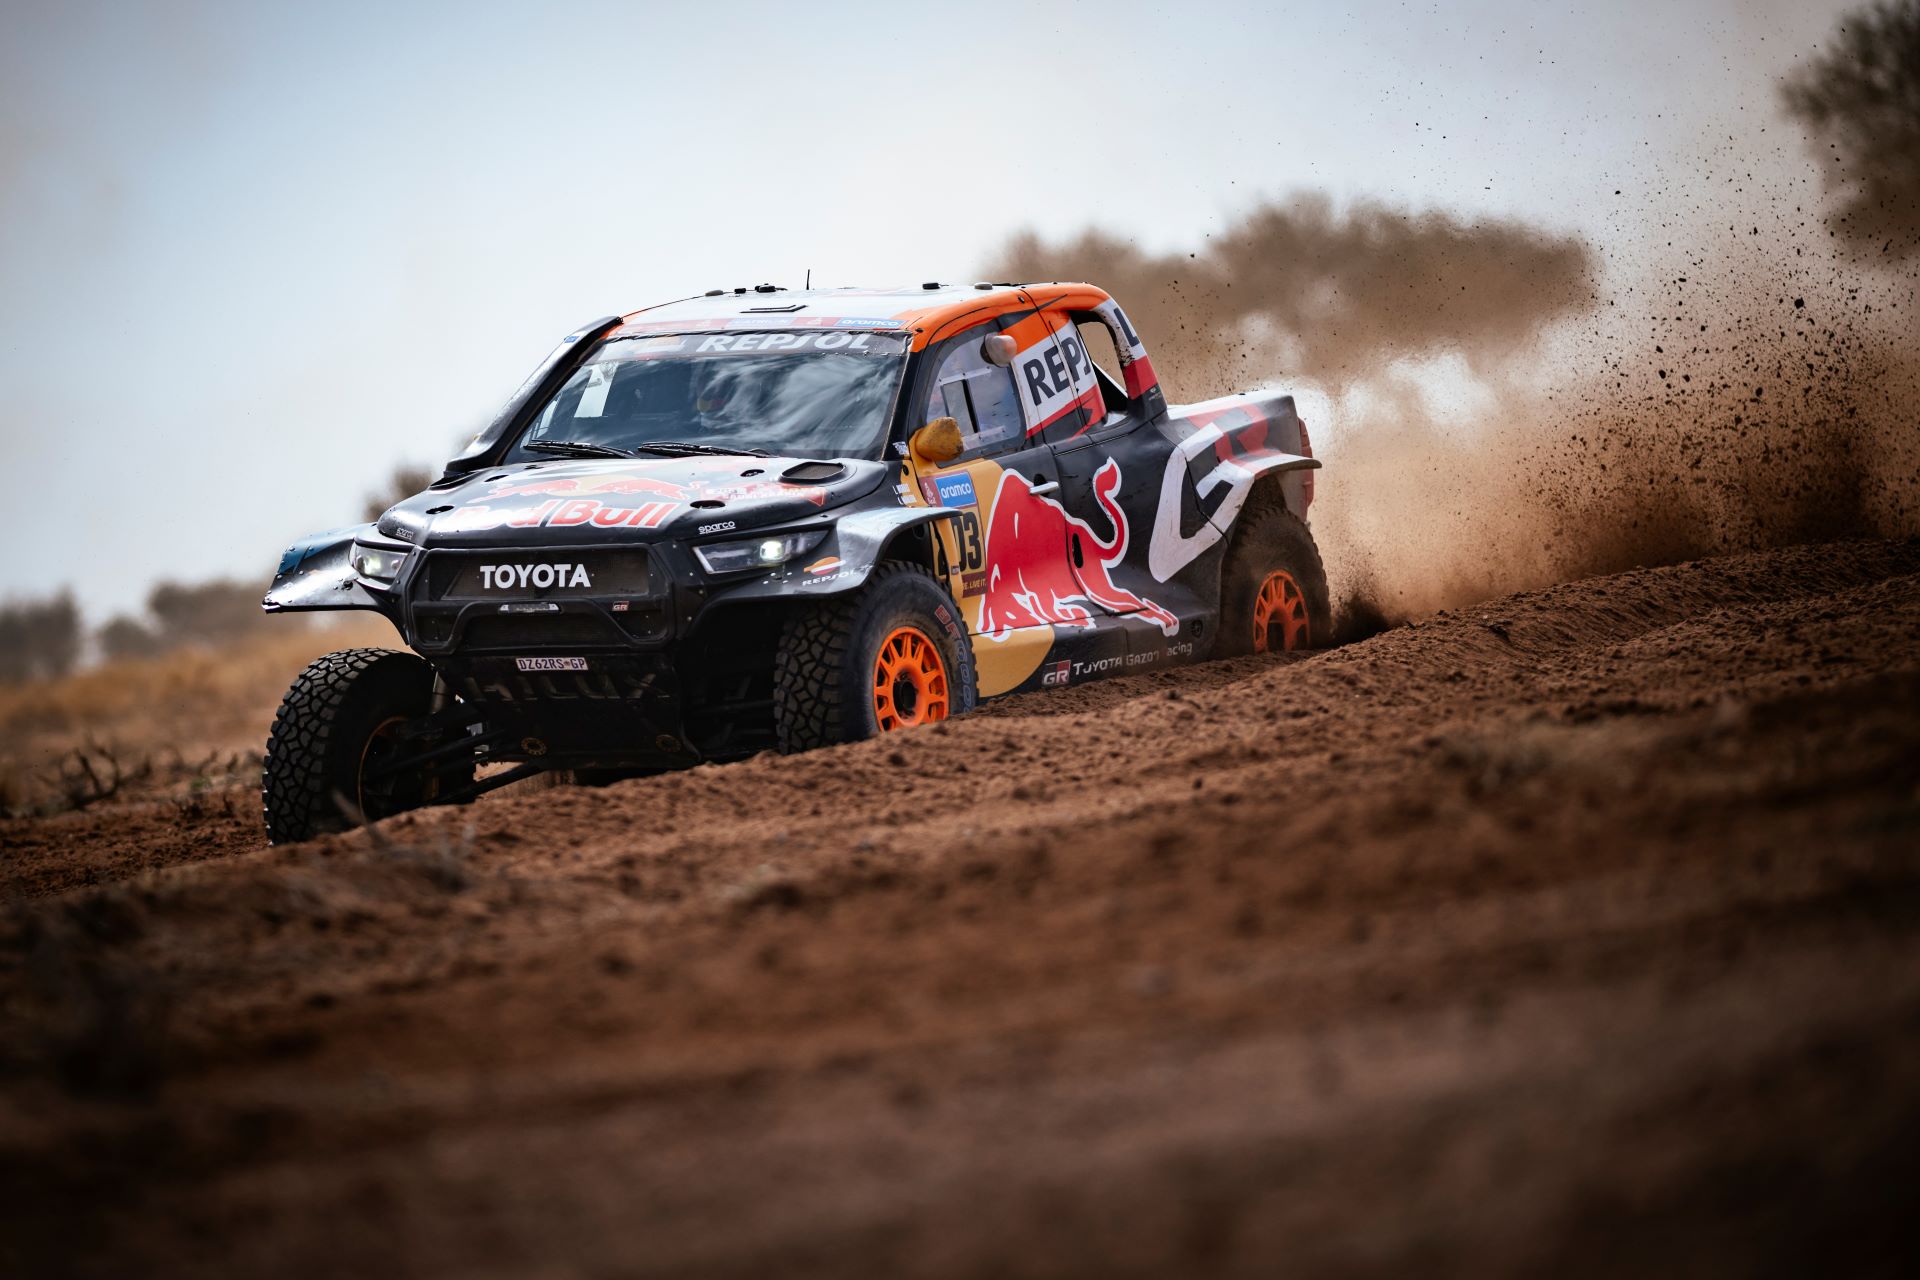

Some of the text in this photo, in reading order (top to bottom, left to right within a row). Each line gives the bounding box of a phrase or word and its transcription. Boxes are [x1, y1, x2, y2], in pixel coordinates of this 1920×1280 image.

[840, 318, 900, 327] aramco
[695, 333, 870, 352] REPSOL
[940, 482, 972, 499] aramco
[698, 521, 737, 534] sparco
[479, 563, 592, 589] TOYOTA
[612, 603, 630, 611] GR
[517, 657, 586, 671] DZ62RS GP
[1042, 669, 1070, 686] GR
